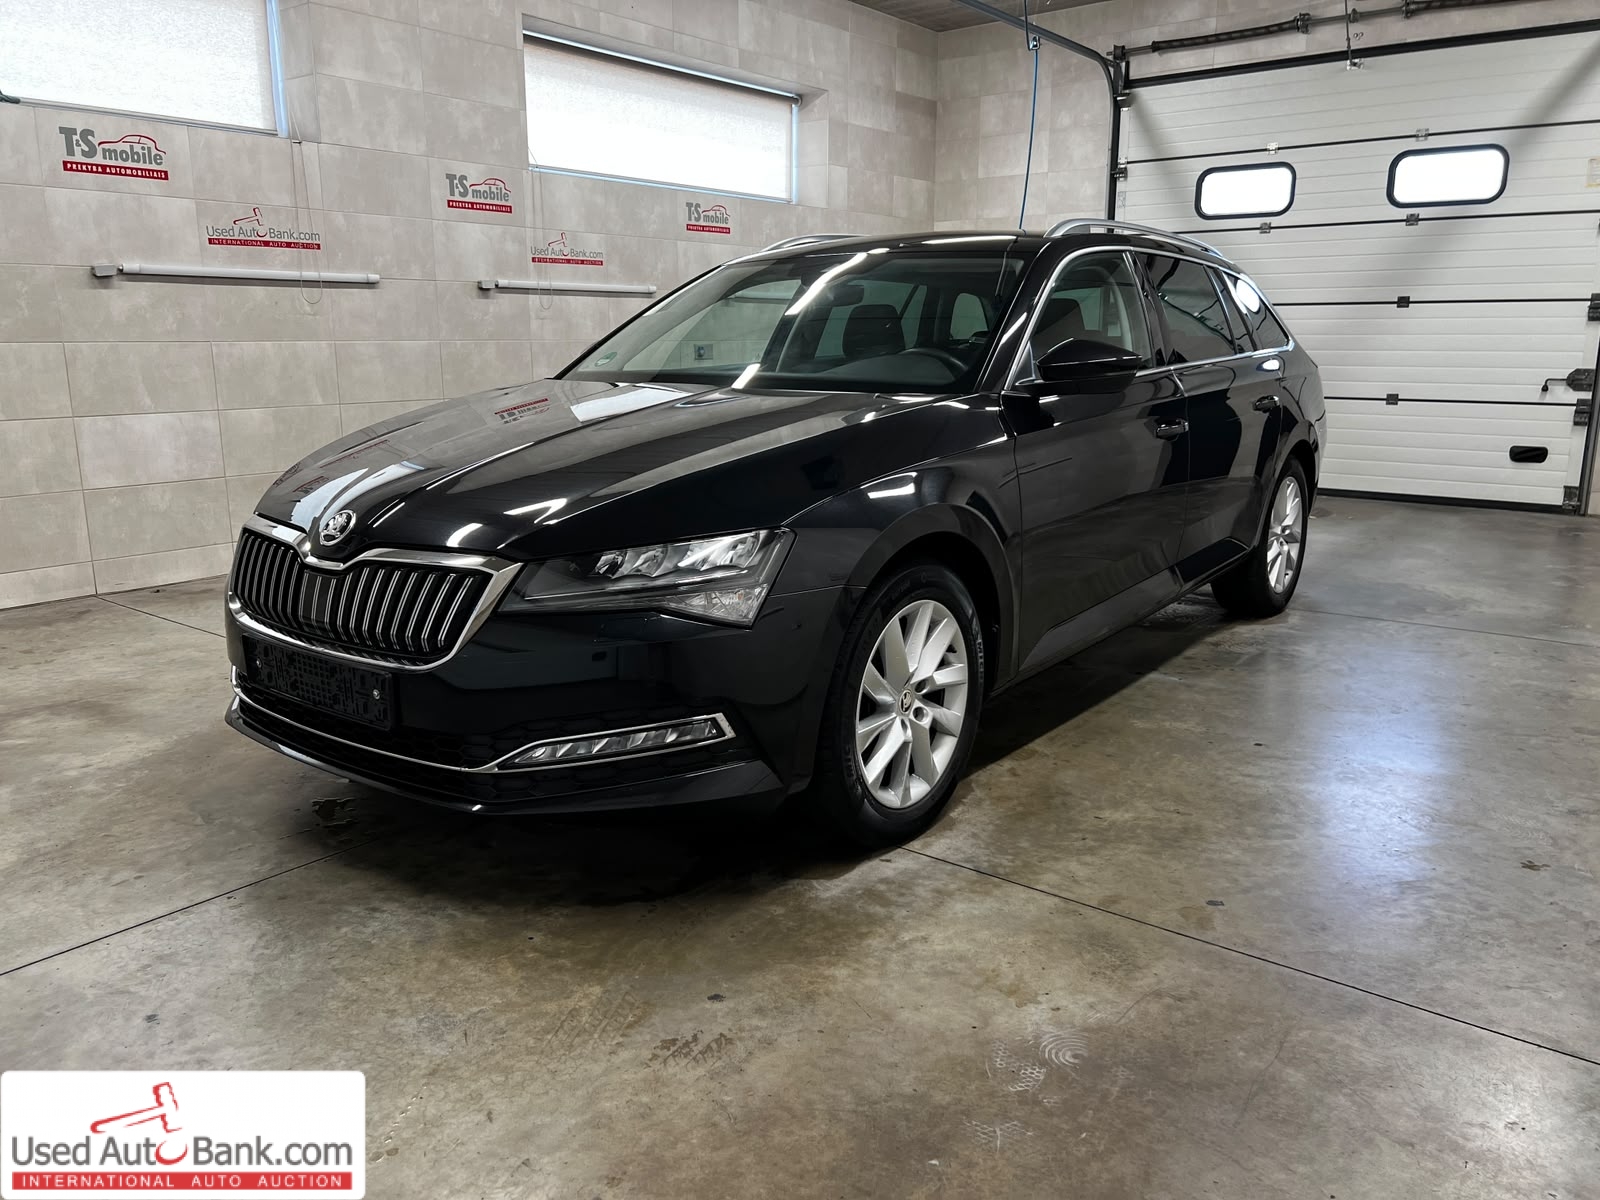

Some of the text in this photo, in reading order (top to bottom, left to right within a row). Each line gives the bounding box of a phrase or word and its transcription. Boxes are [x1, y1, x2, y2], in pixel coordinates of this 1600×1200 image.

[58, 126, 163, 166] T&S mobile
[67, 163, 166, 178] PREKYBA AUTOMOBILIAIS
[472, 186, 510, 202] mobile
[703, 212, 729, 224] mobile
[206, 225, 235, 237] Used
[211, 239, 265, 247] INTERNATIONAL
[530, 246, 549, 256] Used
